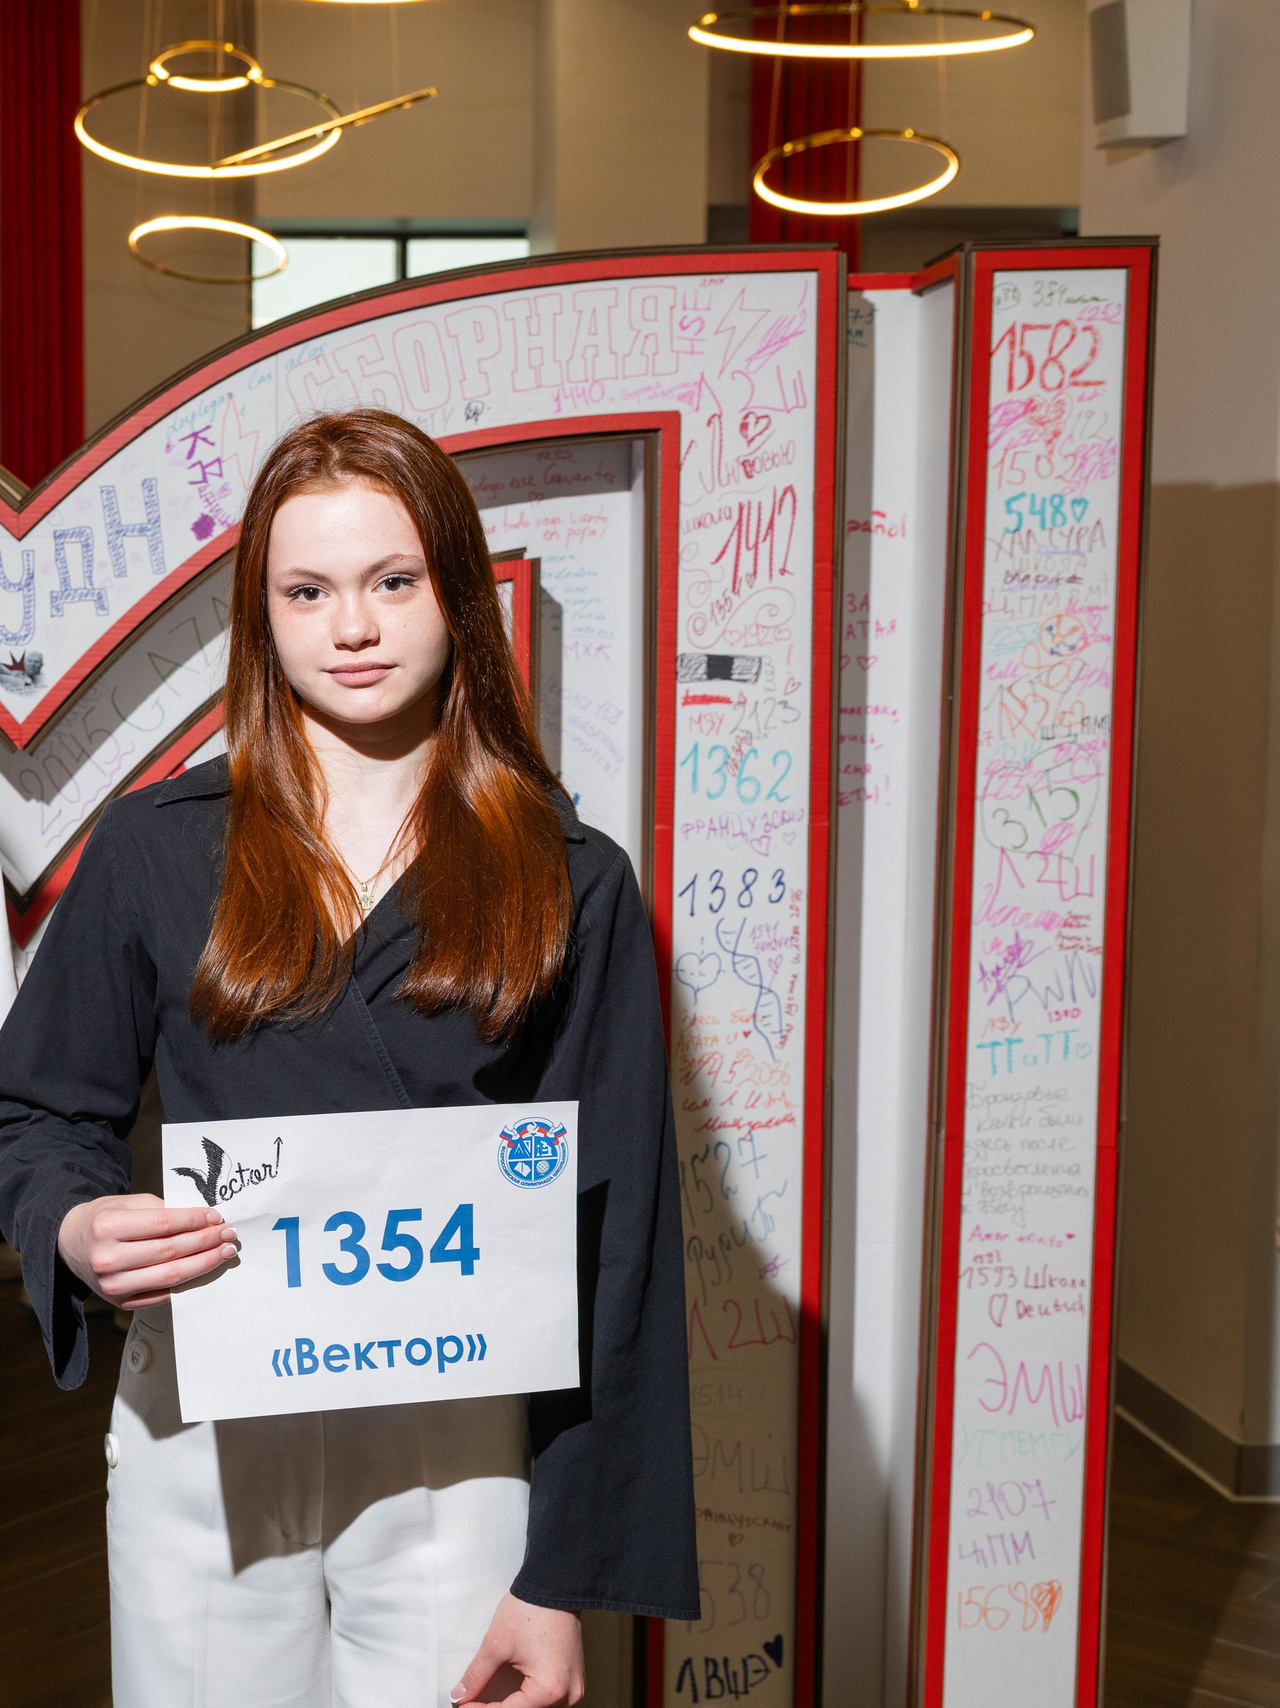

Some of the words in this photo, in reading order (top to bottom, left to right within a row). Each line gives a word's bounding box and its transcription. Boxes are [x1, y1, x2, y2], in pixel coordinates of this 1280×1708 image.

[675, 289, 713, 356] HSE
[990, 318, 1107, 394] 1582
[552, 379, 607, 414] 1440
[846, 509, 908, 541] pañol
[1003, 491, 1069, 535] 548
[679, 741, 794, 805] 1362
[677, 867, 787, 918] 1383
[170, 1135, 278, 1208] Vector
[680, 1131, 769, 1229] 1527
[271, 1203, 481, 1289] 1354
[271, 1332, 488, 1378] «Вектор»
[965, 1341, 1086, 1429] ЭМШ
[965, 1477, 1057, 1522] 2107
[686, 1560, 771, 1635] 538
[956, 1578, 1039, 1633] 1568
